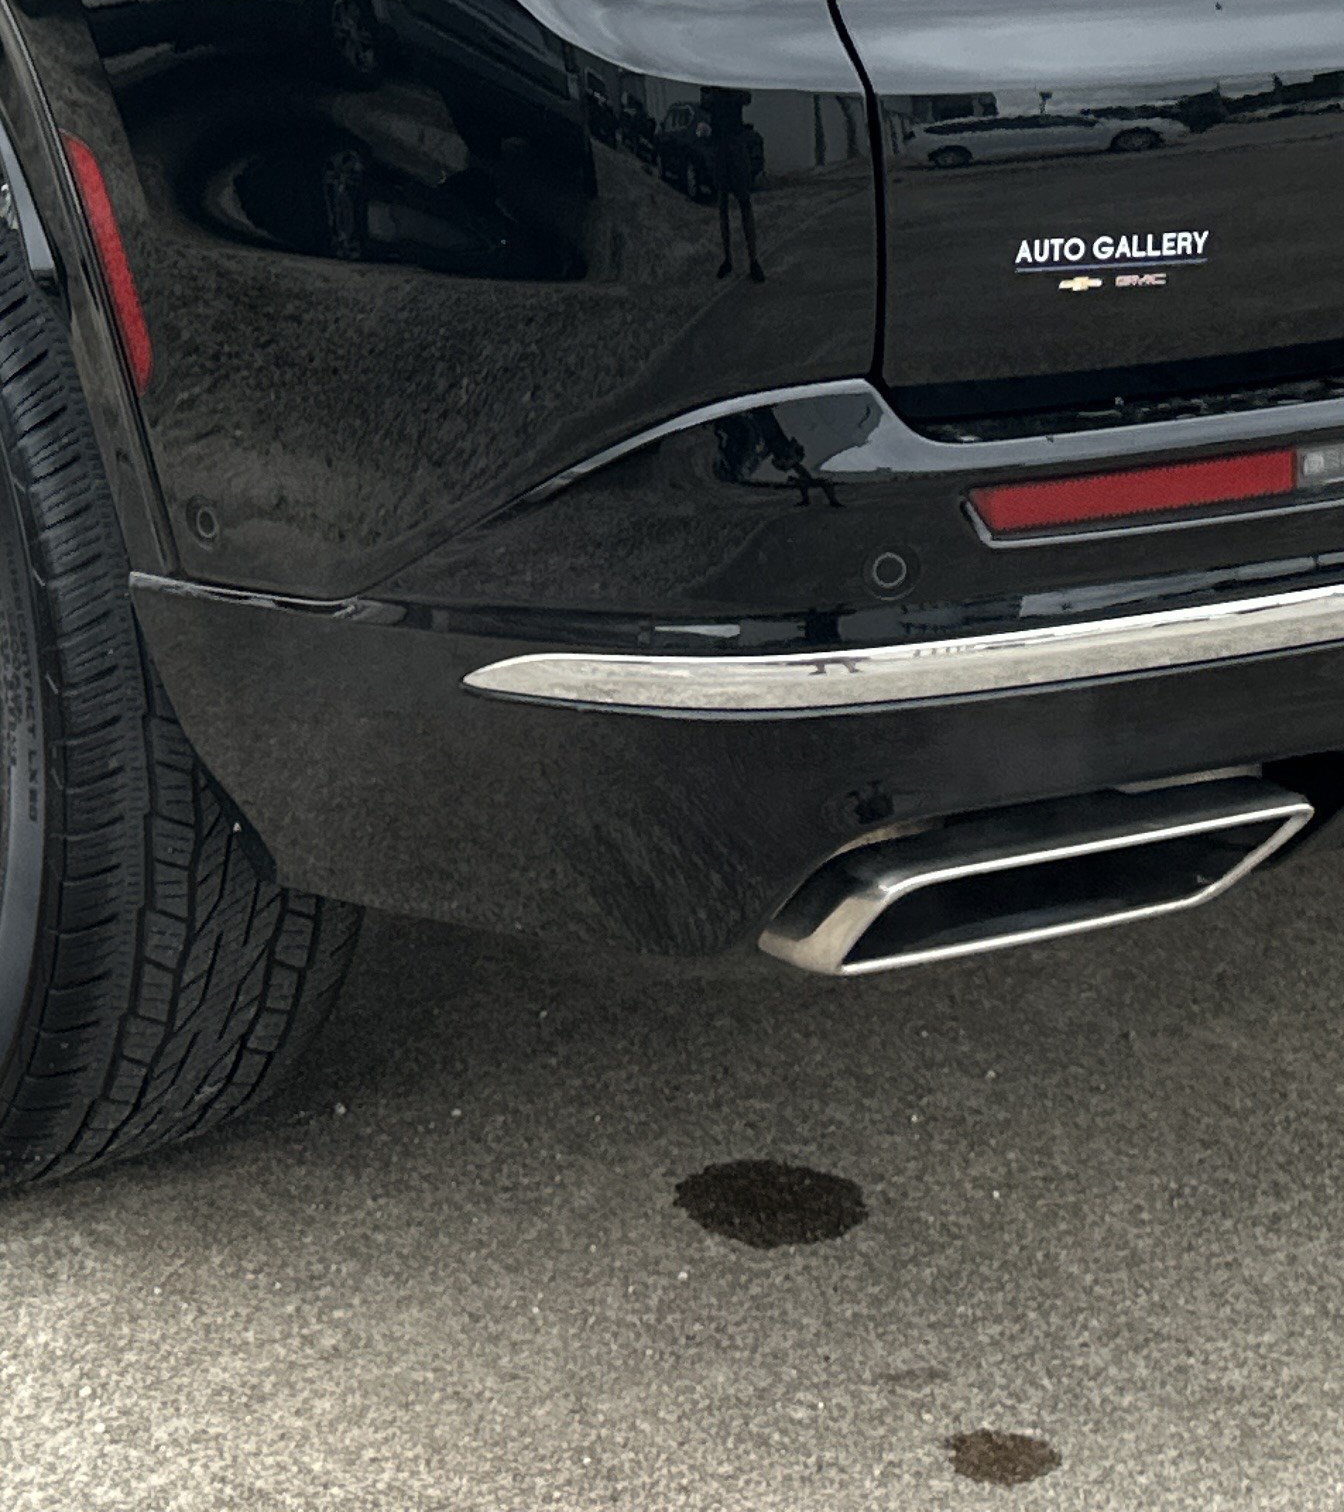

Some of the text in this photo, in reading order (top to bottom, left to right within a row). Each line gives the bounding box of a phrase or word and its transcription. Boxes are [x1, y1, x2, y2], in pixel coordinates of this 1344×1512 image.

[1014, 230, 1210, 264] AUTO GALLERY
[1114, 273, 1168, 287] GMC
